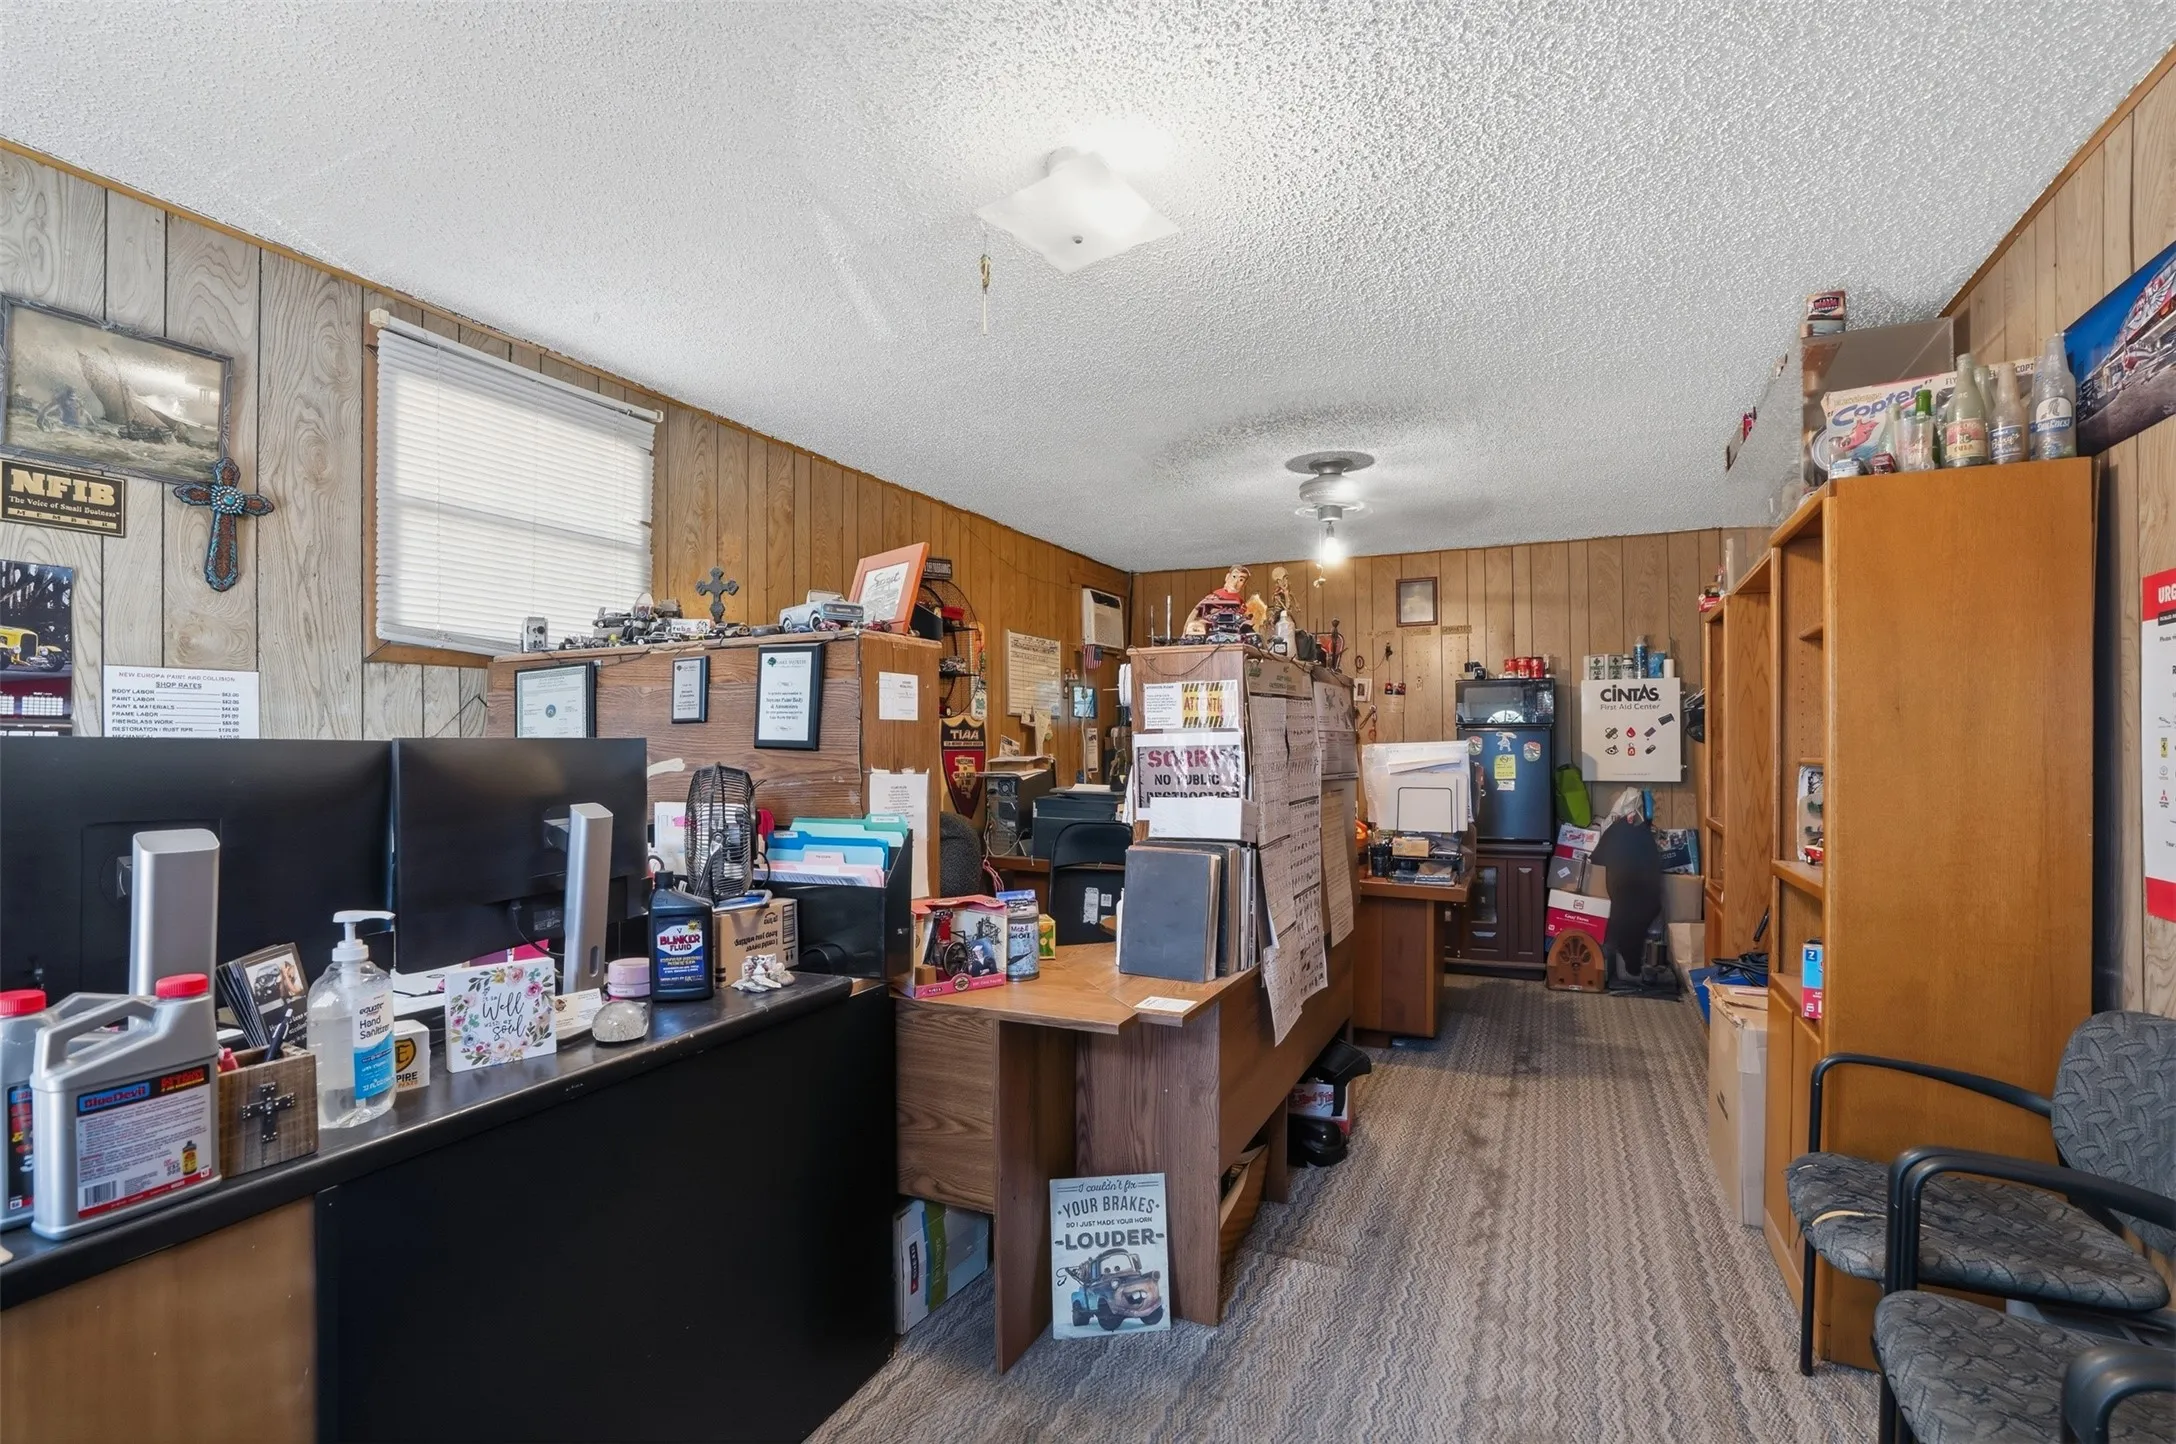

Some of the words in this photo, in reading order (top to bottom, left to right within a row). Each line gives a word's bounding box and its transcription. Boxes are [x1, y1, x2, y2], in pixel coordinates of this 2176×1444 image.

[1832, 384, 1923, 427] Copter
[10, 468, 116, 507] NFIB
[9, 495, 25, 504] The
[27, 497, 48, 508] Voice
[50, 502, 60, 510] of
[60, 503, 82, 513] Small
[178, 682, 202, 690] RATES
[1600, 684, 1660, 702] CINTAS
[1154, 774, 1171, 785] NO
[1177, 773, 1220, 785] UBLC
[660, 934, 701, 945] BLINKER
[359, 1002, 385, 1015] equate
[483, 992, 525, 1021] Well
[360, 1015, 381, 1029] Hand
[492, 1014, 527, 1042] soul
[360, 1023, 390, 1040] Sanitizer
[1086, 1179, 1122, 1192] couldn't
[1124, 1180, 1138, 1193] fix
[1063, 1197, 1098, 1219] YOUR
[1103, 1195, 1155, 1214] BRAKES
[1080, 1220, 1096, 1228] JUST
